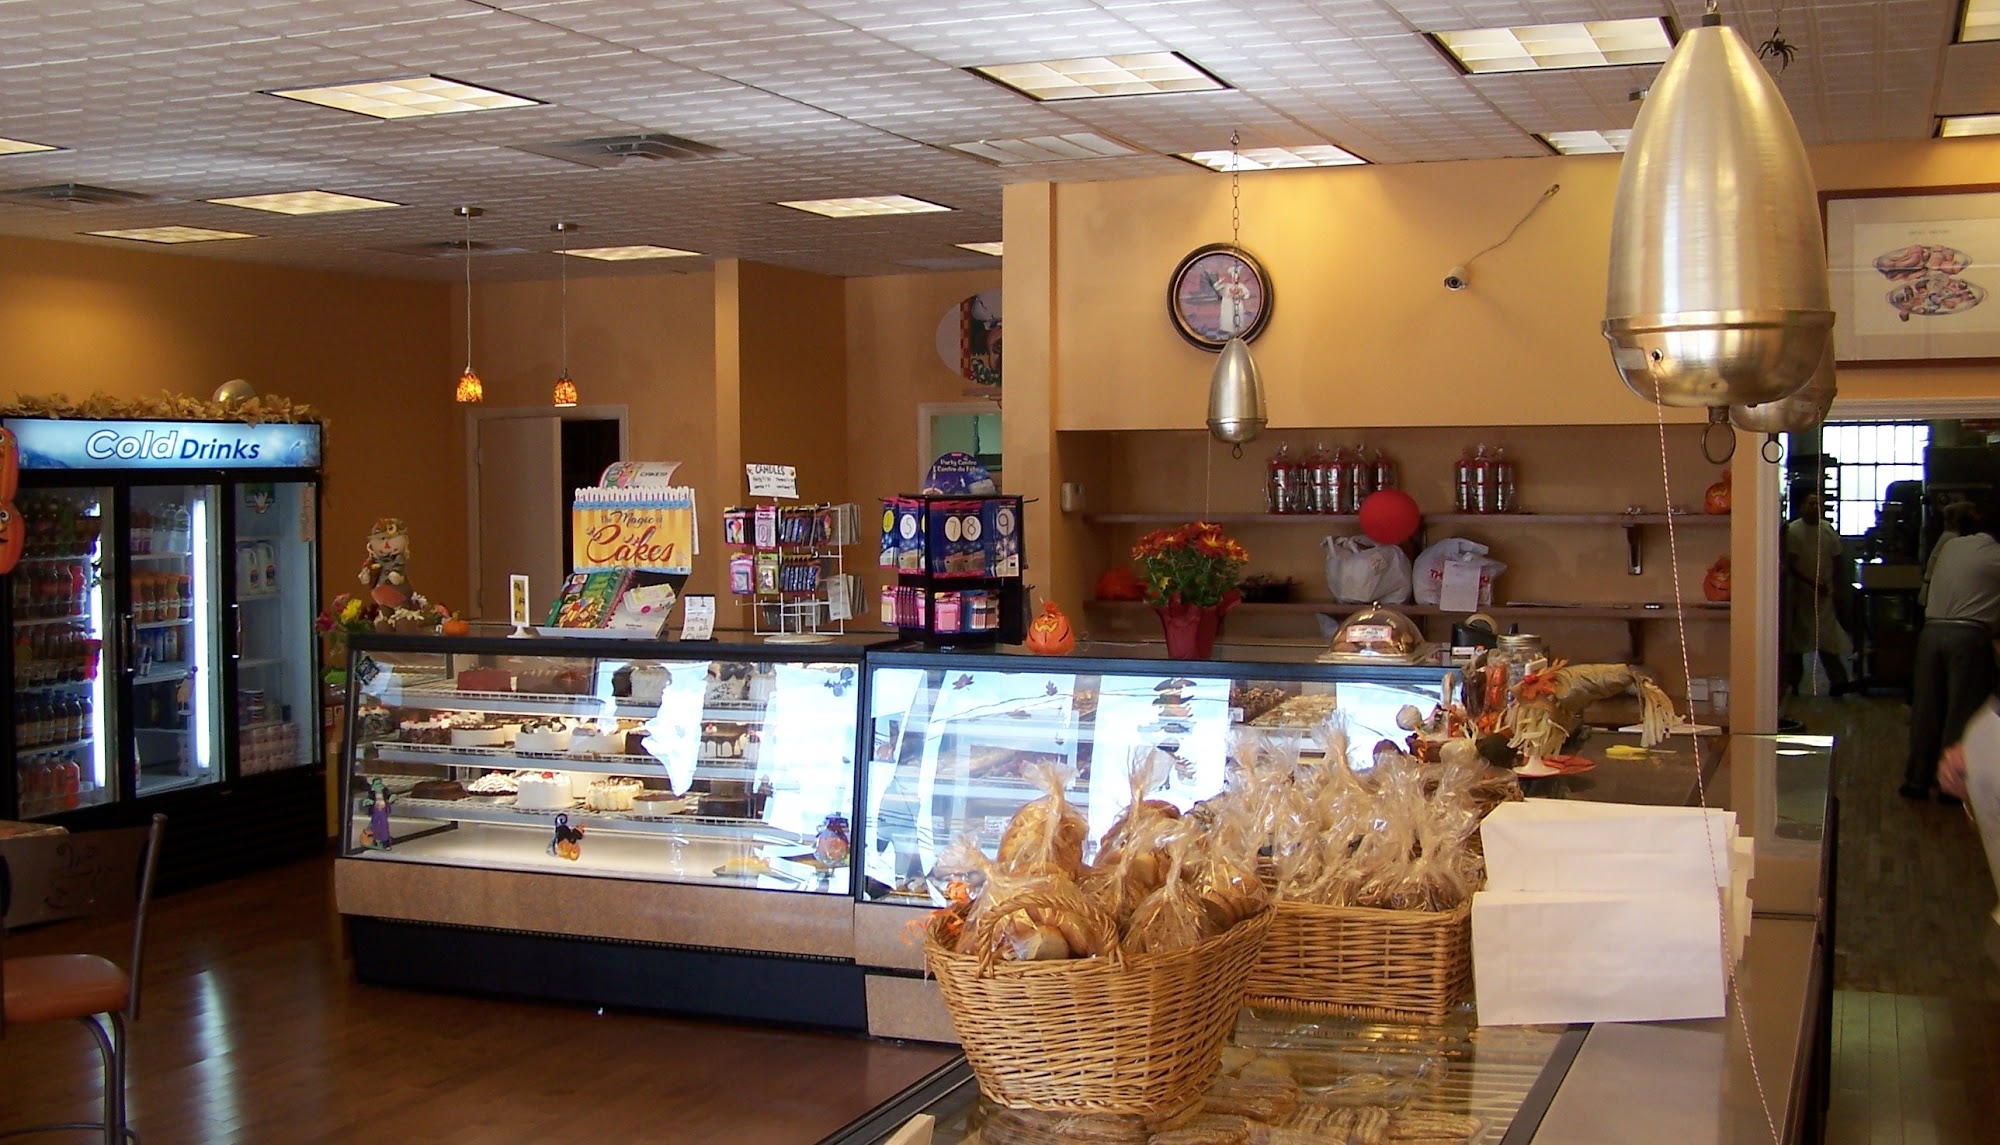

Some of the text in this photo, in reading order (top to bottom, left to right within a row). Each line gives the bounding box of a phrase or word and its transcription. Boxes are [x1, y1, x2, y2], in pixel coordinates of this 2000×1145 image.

[86, 429, 260, 459] Cold Drinks
[755, 465, 786, 476] CANDLES
[610, 510, 655, 528] Magic
[948, 520, 957, 538] 7
[966, 517, 977, 537] 8
[998, 513, 1009, 535] 9
[586, 524, 675, 565] Cakes
